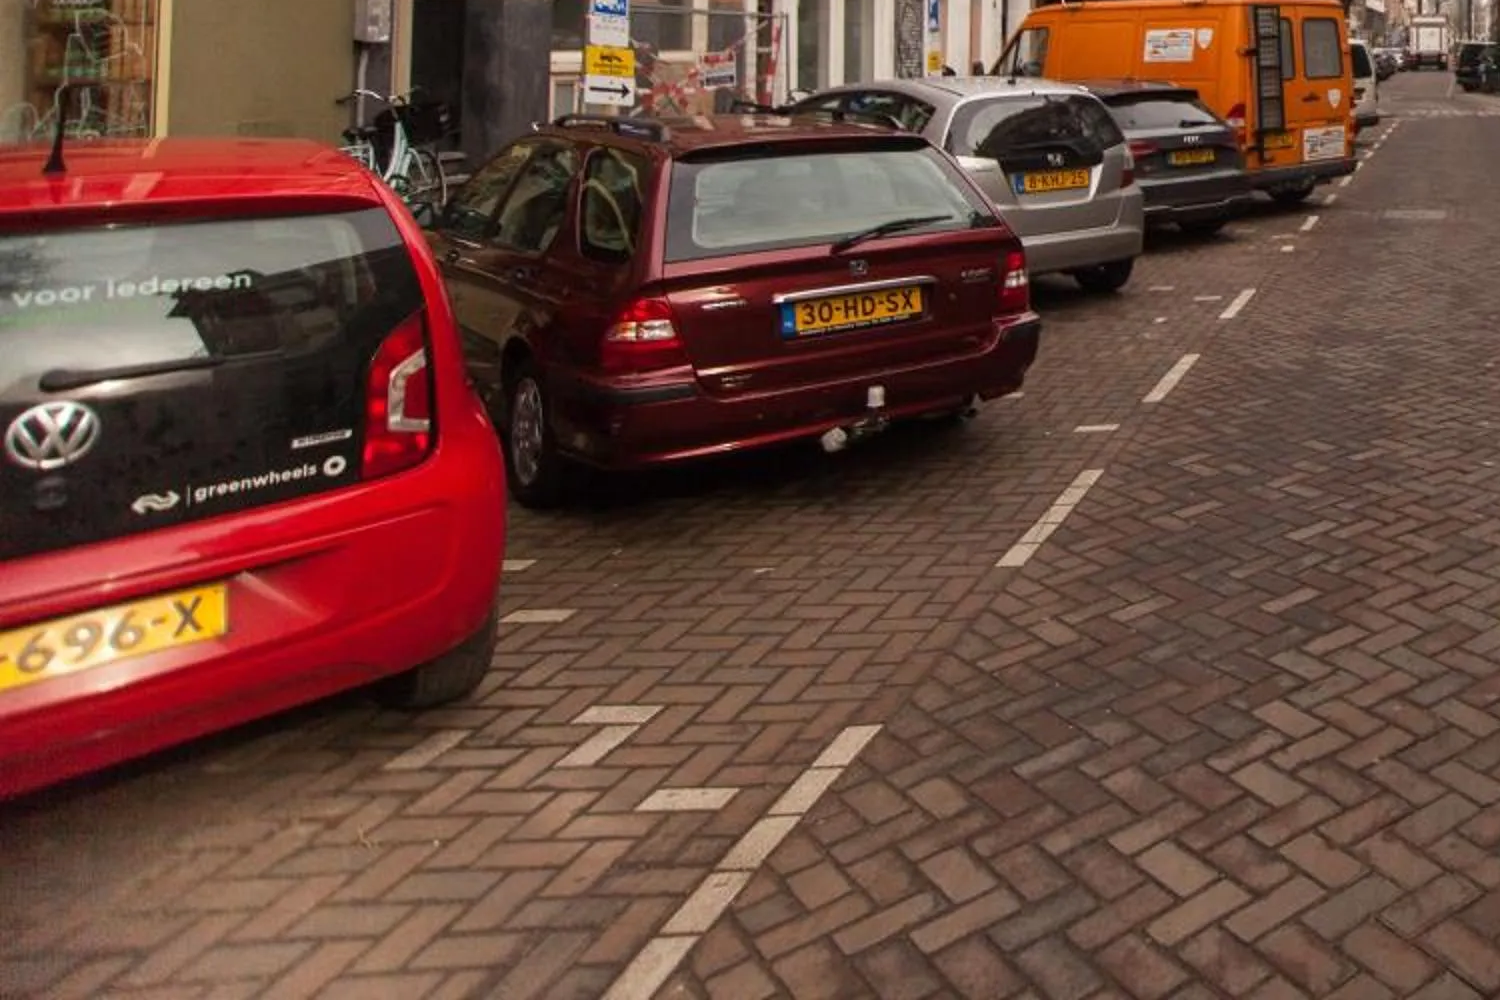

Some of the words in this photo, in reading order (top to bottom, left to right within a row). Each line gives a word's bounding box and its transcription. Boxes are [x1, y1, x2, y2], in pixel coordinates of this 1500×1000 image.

[11, 286, 97, 308] voor
[801, 289, 915, 325] 30-HD-SX
[194, 464, 317, 502] greenwheels
